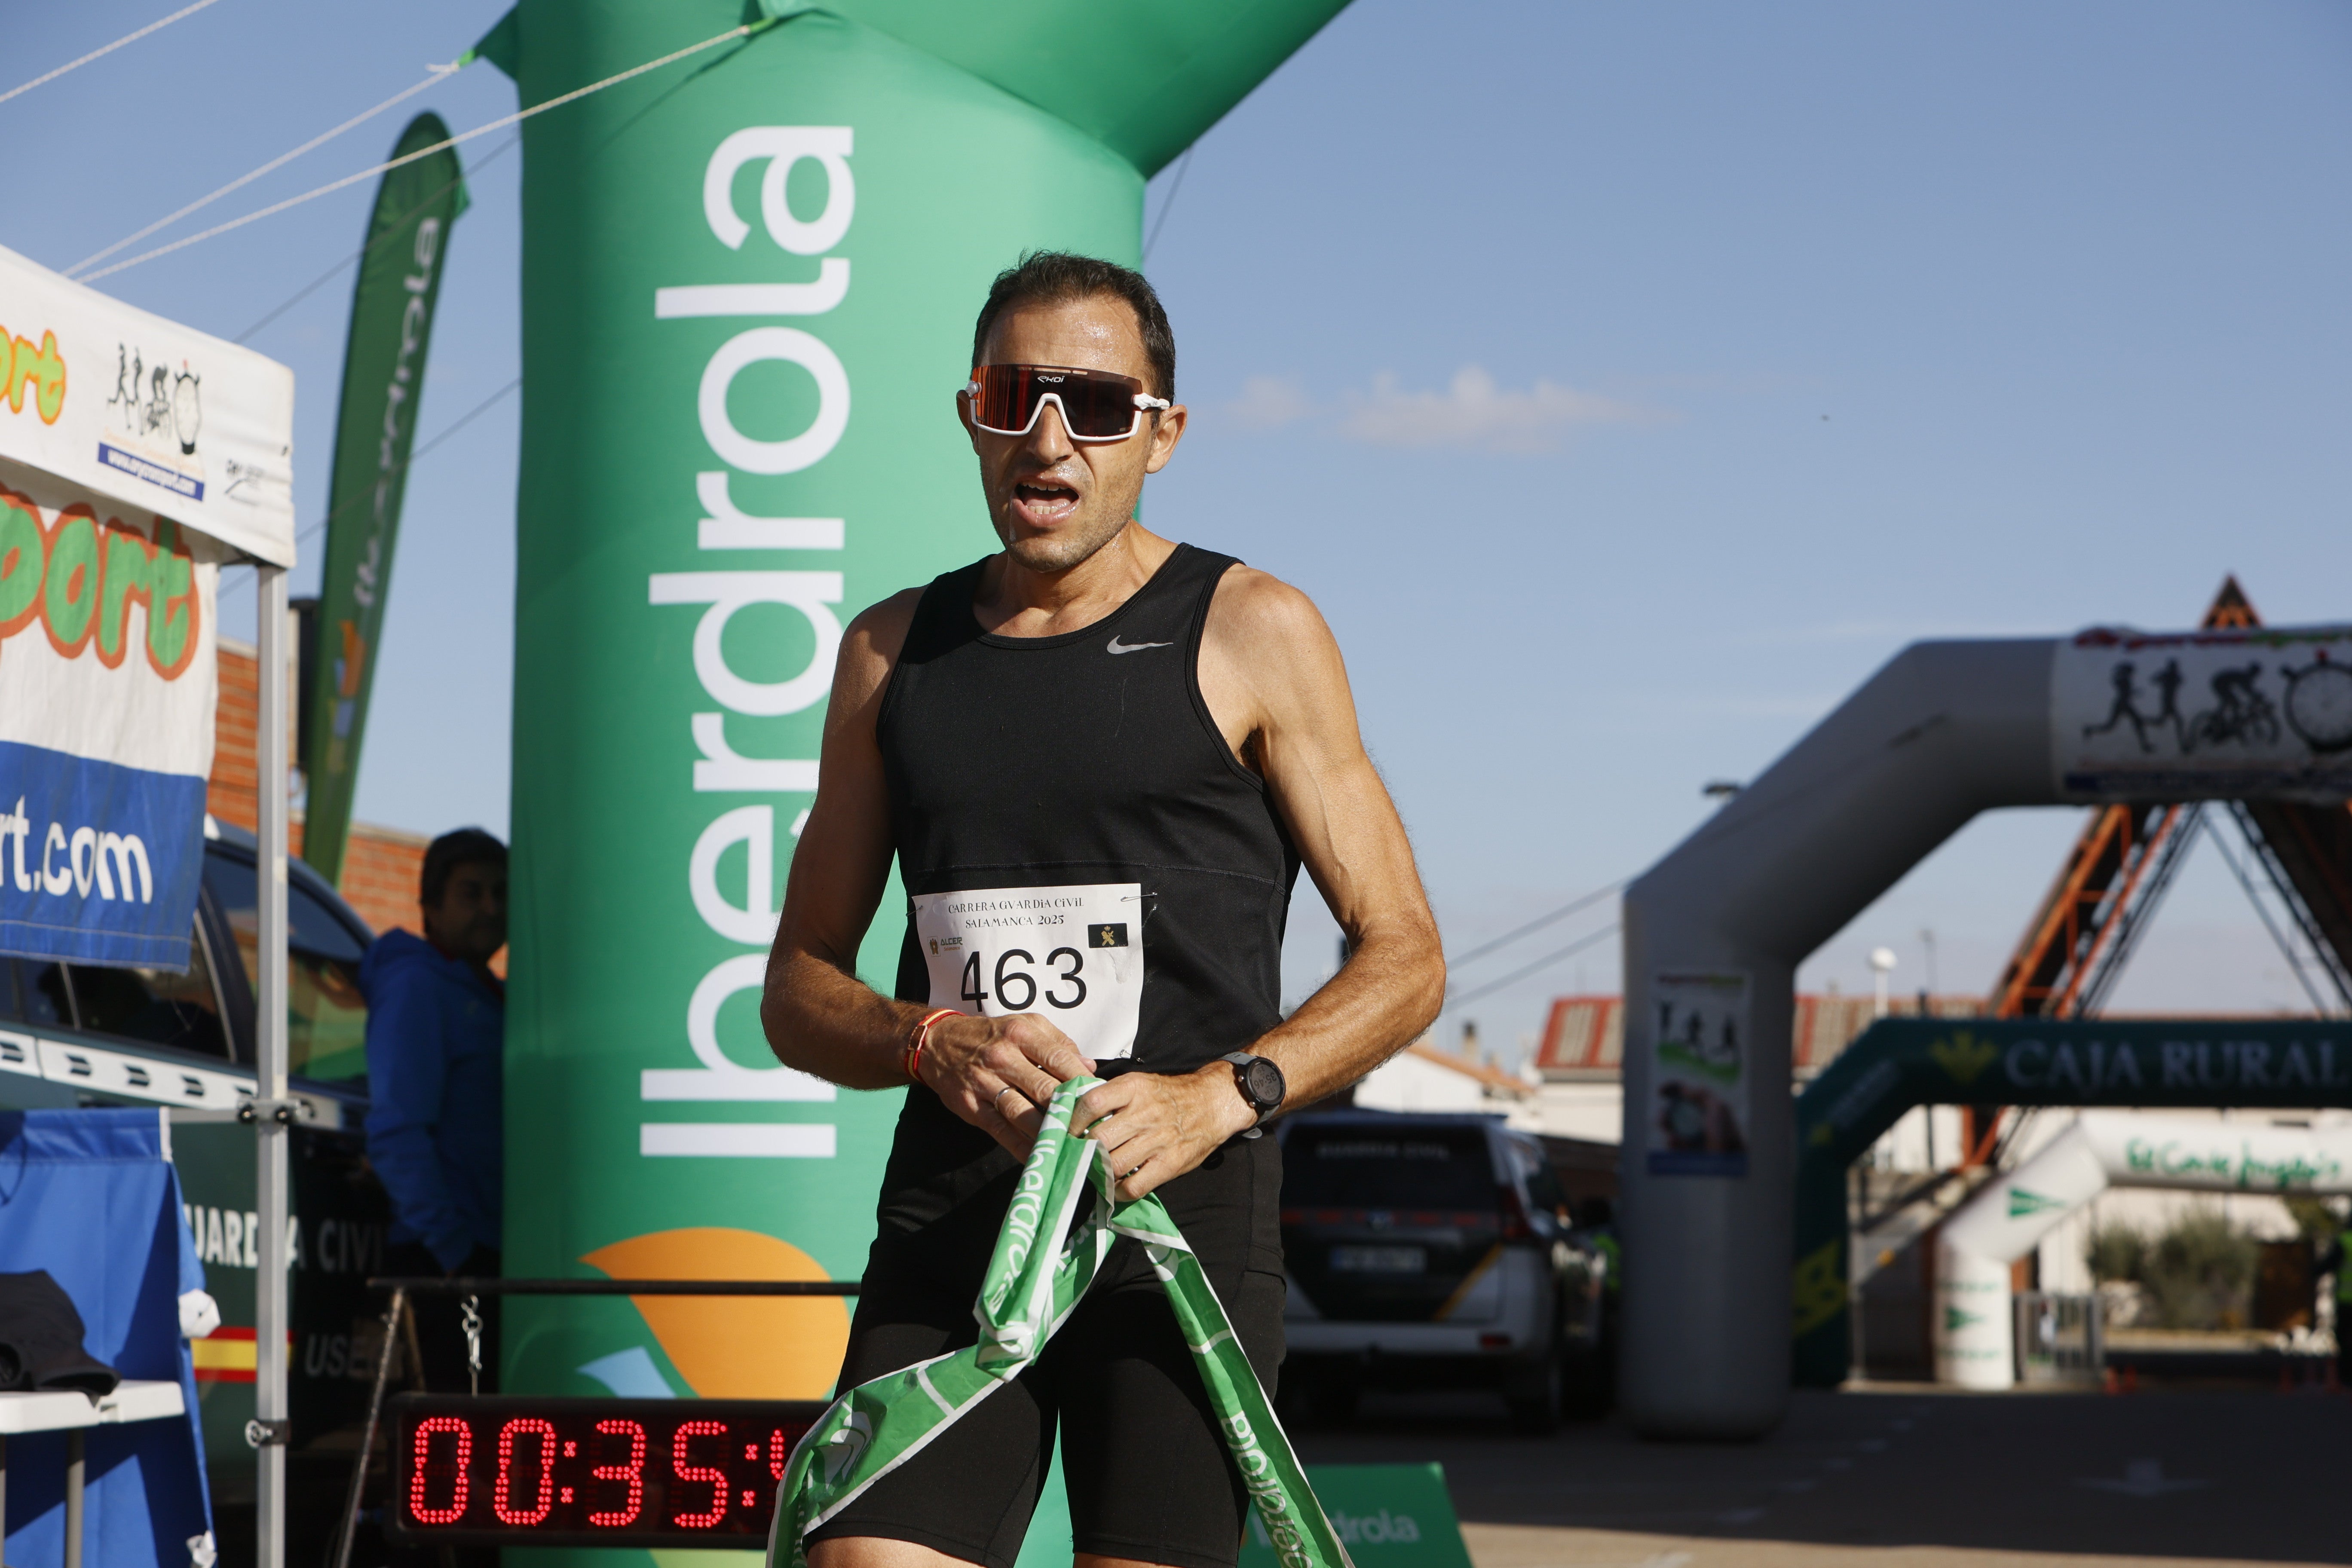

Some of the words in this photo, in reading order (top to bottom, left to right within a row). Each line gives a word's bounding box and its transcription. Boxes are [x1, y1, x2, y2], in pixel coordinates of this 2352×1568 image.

[641, 126, 856, 1156] Iberdrola
[949, 902, 996, 914] CARRERA
[966, 916, 1033, 928] SALAMANCA
[1038, 915, 1064, 925] 2025
[941, 937, 963, 946] ALCER
[961, 947, 1087, 1012] 463
[2003, 1039, 2143, 1096] CAJA
[2161, 1039, 2348, 1089] RURAL
[1255, 1072, 1277, 1089] 35:46
